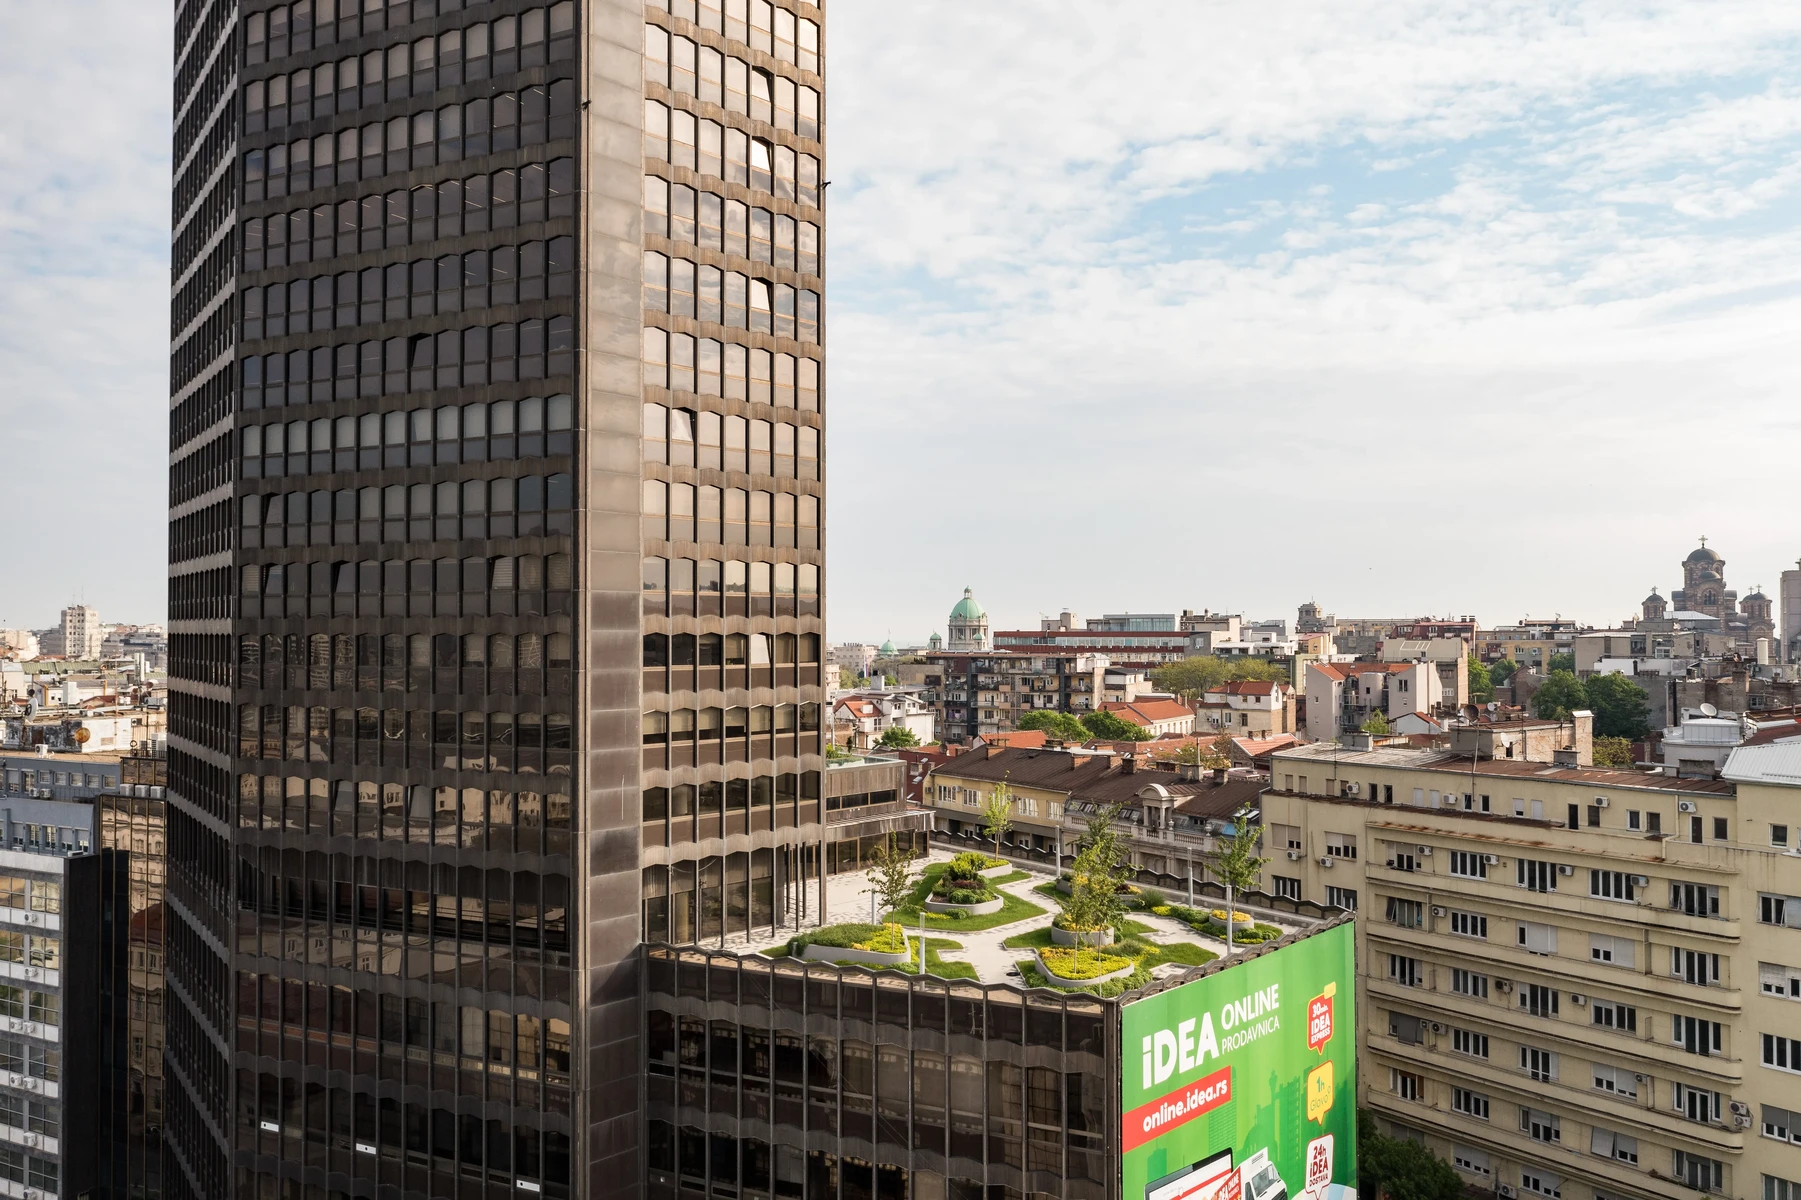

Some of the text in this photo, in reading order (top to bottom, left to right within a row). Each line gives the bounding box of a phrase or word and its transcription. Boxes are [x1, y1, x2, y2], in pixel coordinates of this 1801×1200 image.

[1221, 983, 1280, 1030] ONLINE
[1222, 1015, 1280, 1055] PRODAVNICA
[1310, 1027, 1331, 1044] EXPRESS
[1316, 1076, 1325, 1093] 1h
[1143, 1079, 1228, 1132] online.idea.rs
[1313, 1144, 1327, 1160] 24h
[1309, 1172, 1328, 1187] DOSTAVA
